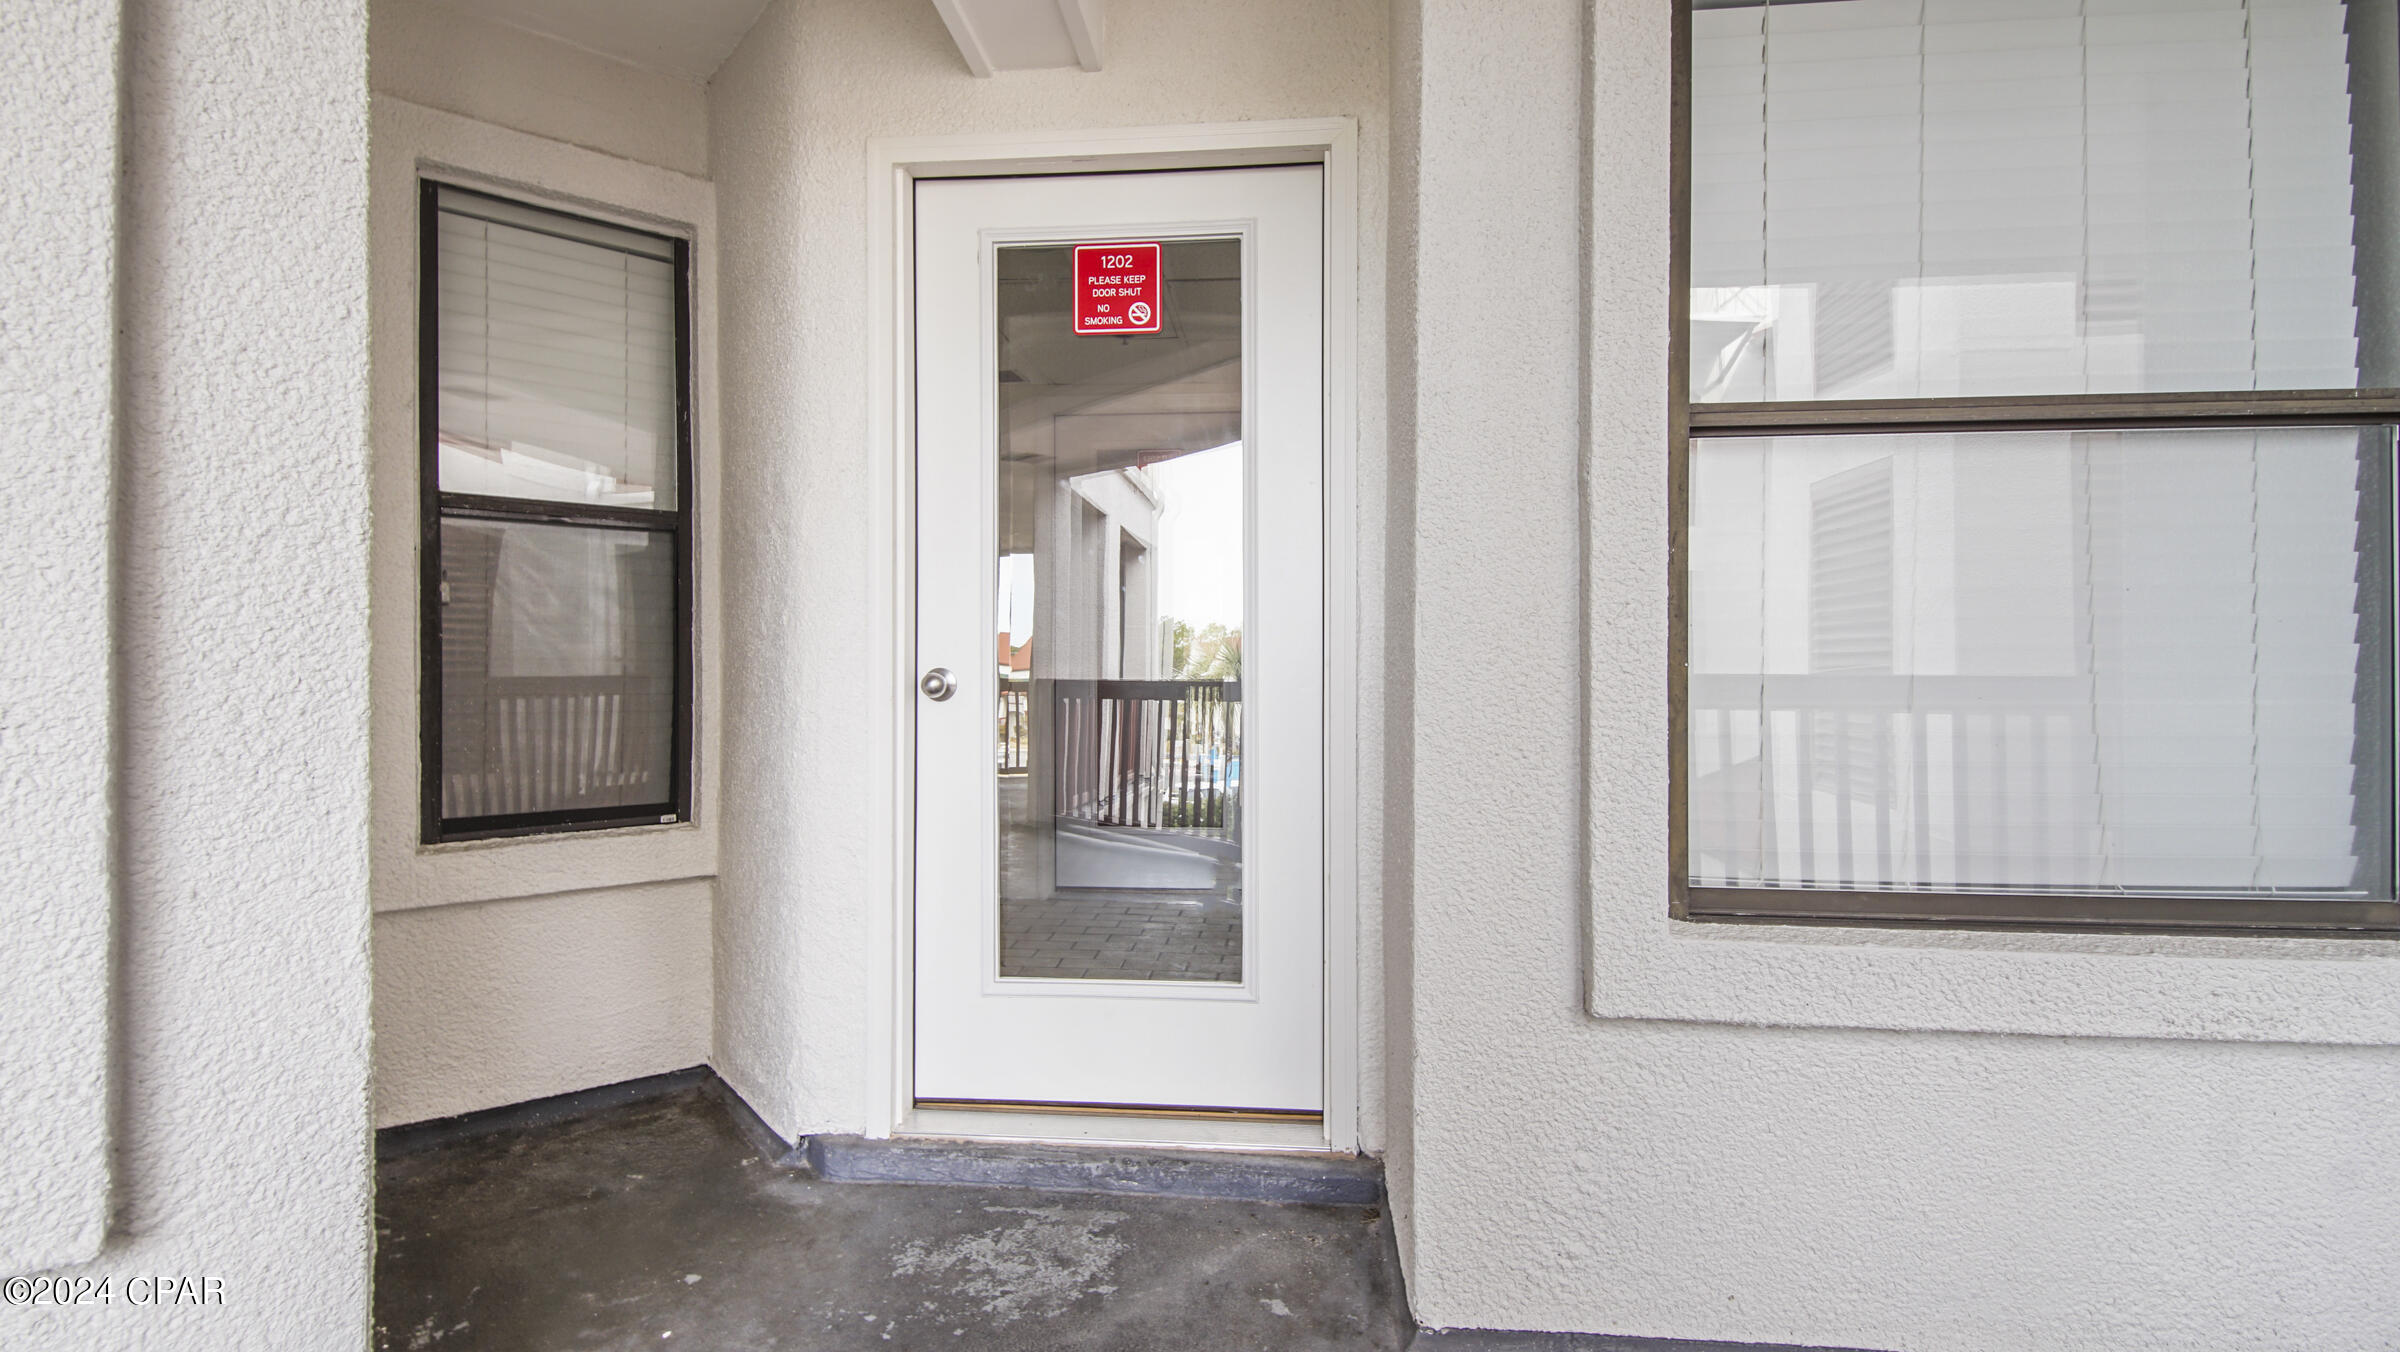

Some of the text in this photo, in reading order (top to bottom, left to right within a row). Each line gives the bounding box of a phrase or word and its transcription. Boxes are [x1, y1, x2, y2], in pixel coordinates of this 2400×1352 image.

[1101, 255, 1133, 269] 1202
[1088, 275, 1146, 285] PLEASE KEEP
[1092, 287, 1142, 297] DOOR SHUT
[1097, 304, 1110, 313] NO
[1084, 316, 1123, 325] SMOKING
